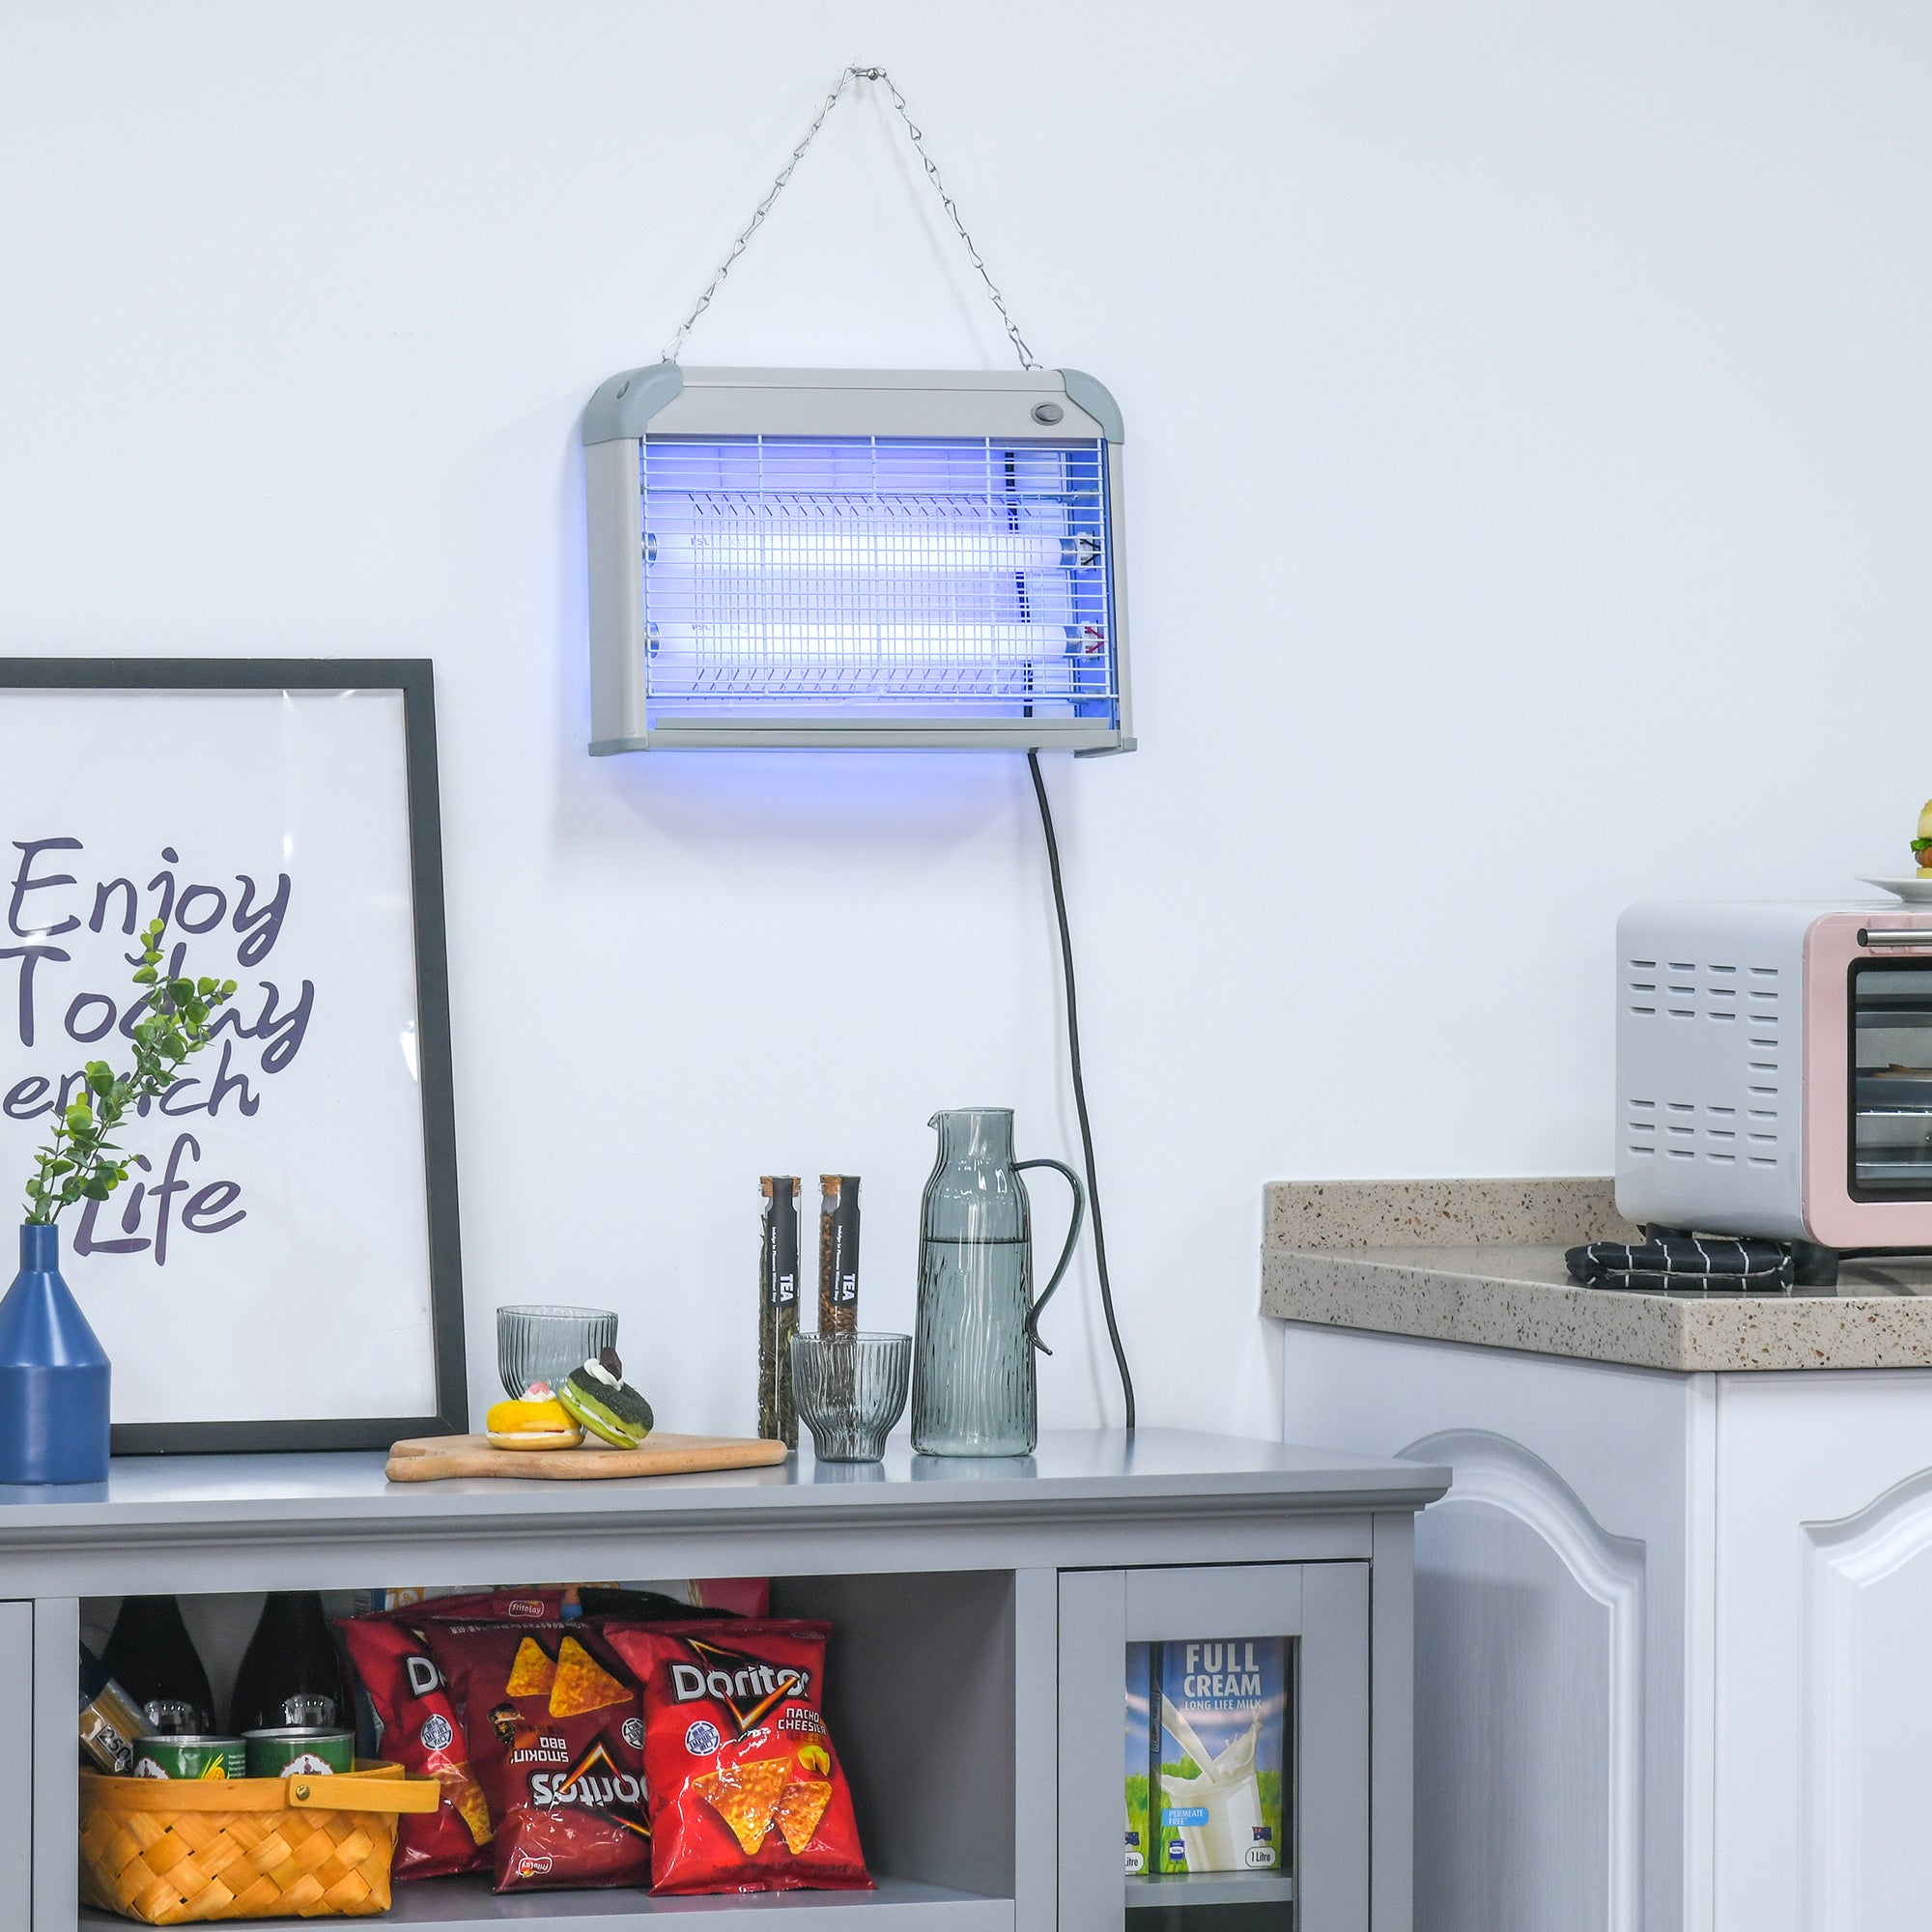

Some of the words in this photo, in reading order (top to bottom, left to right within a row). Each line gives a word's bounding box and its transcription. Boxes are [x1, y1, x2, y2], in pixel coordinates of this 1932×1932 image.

[9, 838, 291, 967] Enjoy
[73, 1133, 247, 1266] Life
[780, 1273, 794, 1302] TEA
[842, 1272, 856, 1301] TEA
[1186, 1642, 1260, 1673] FULL
[1183, 1673, 1262, 1697] CREAM
[786, 1708, 819, 1723] NACHO
[1185, 1700, 1210, 1711] LONG
[1214, 1699, 1235, 1710] LIFE
[1236, 1698, 1262, 1710] MILK
[539, 1736, 567, 1749] BBQ
[689, 1729, 715, 1749] IMPORT
[1169, 1809, 1204, 1818] PERMEATE
[1251, 1851, 1255, 1862] 1
[1256, 1850, 1271, 1862] Litre
